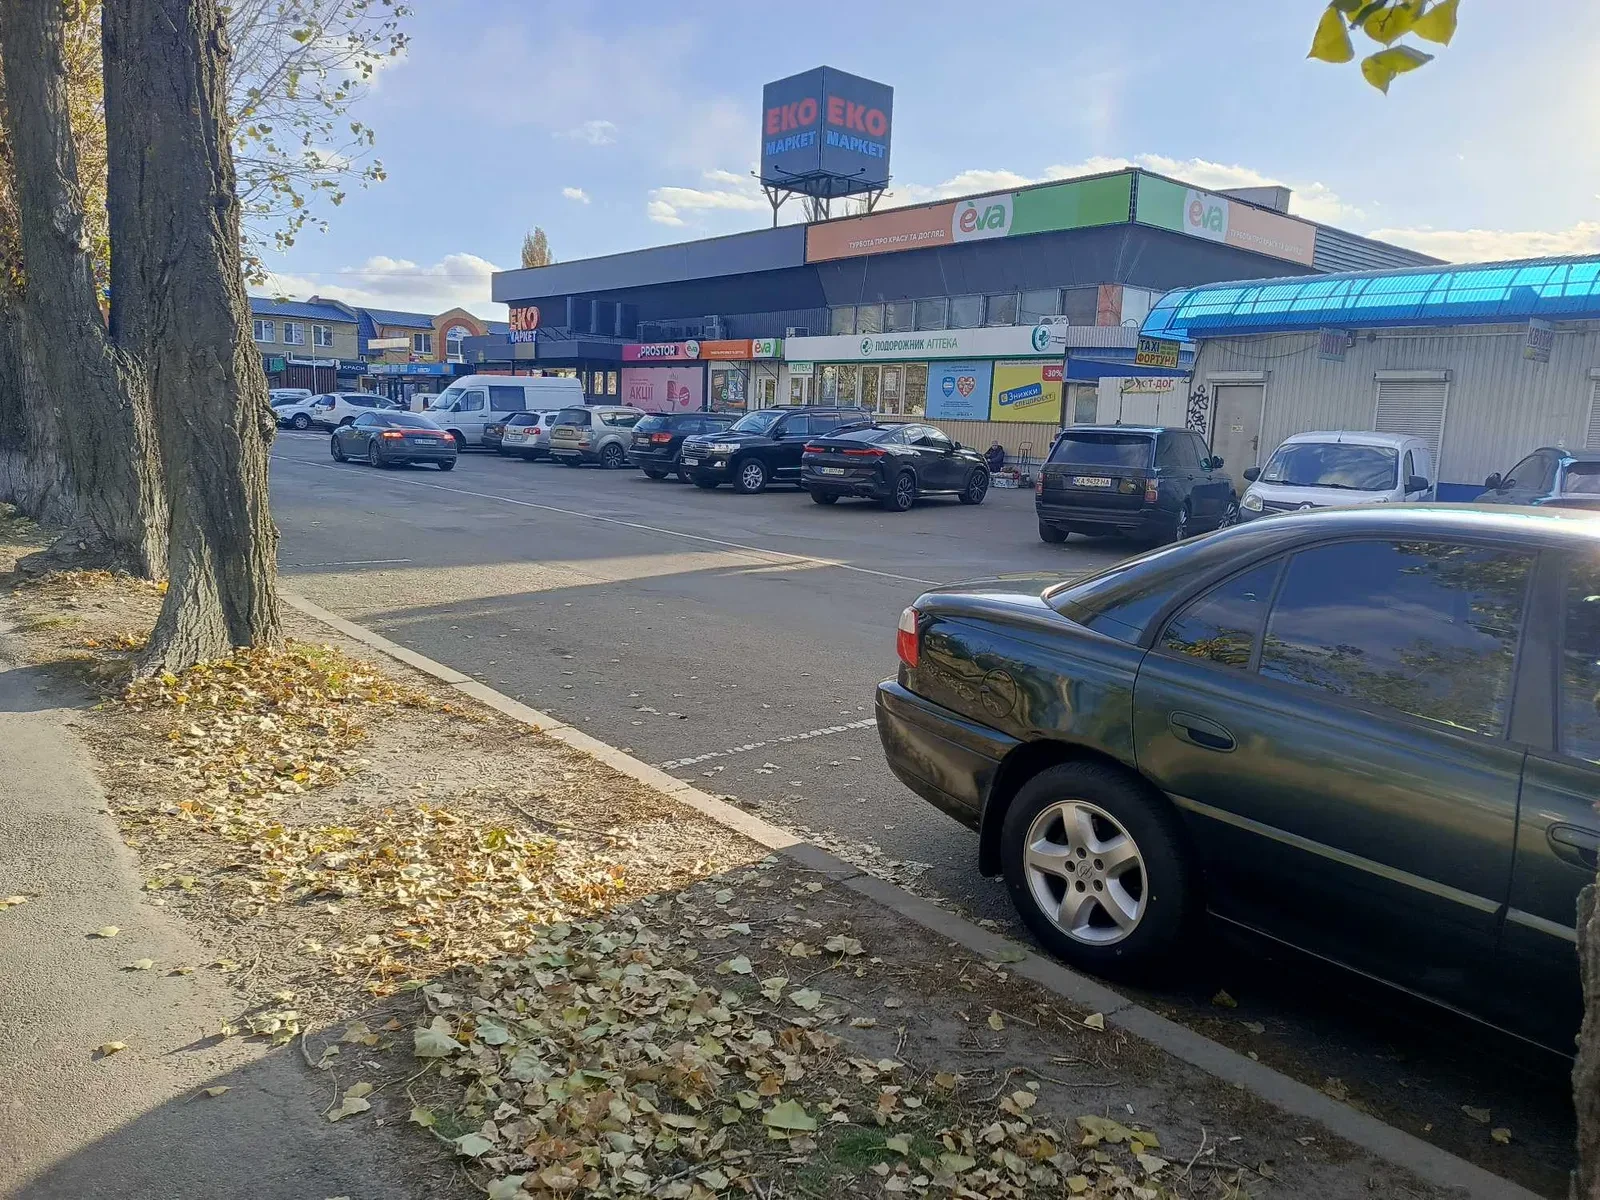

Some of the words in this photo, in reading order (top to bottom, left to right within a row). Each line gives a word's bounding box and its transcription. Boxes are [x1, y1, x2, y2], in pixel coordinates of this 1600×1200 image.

[766, 97, 818, 136] ЕКО
[827, 95, 888, 137] ЕКО
[766, 130, 817, 156] МАРКЕТ
[826, 130, 886, 158] МАРКЕТ
[849, 239, 874, 249] ТУРБОТА
[875, 237, 888, 246] ПРО
[888, 234, 908, 243] КРАСУ
[909, 232, 917, 240] ТА
[918, 229, 945, 240] ДОГЛЯД
[509, 306, 541, 331] ЕКО
[641, 345, 676, 357] PROSTOR
[875, 339, 924, 352] ПОДОРОЖНИК
[926, 338, 958, 349] АПТЕКА
[792, 364, 812, 372] АПТЕКА
[1137, 352, 1176, 366] ФОРТУНА
